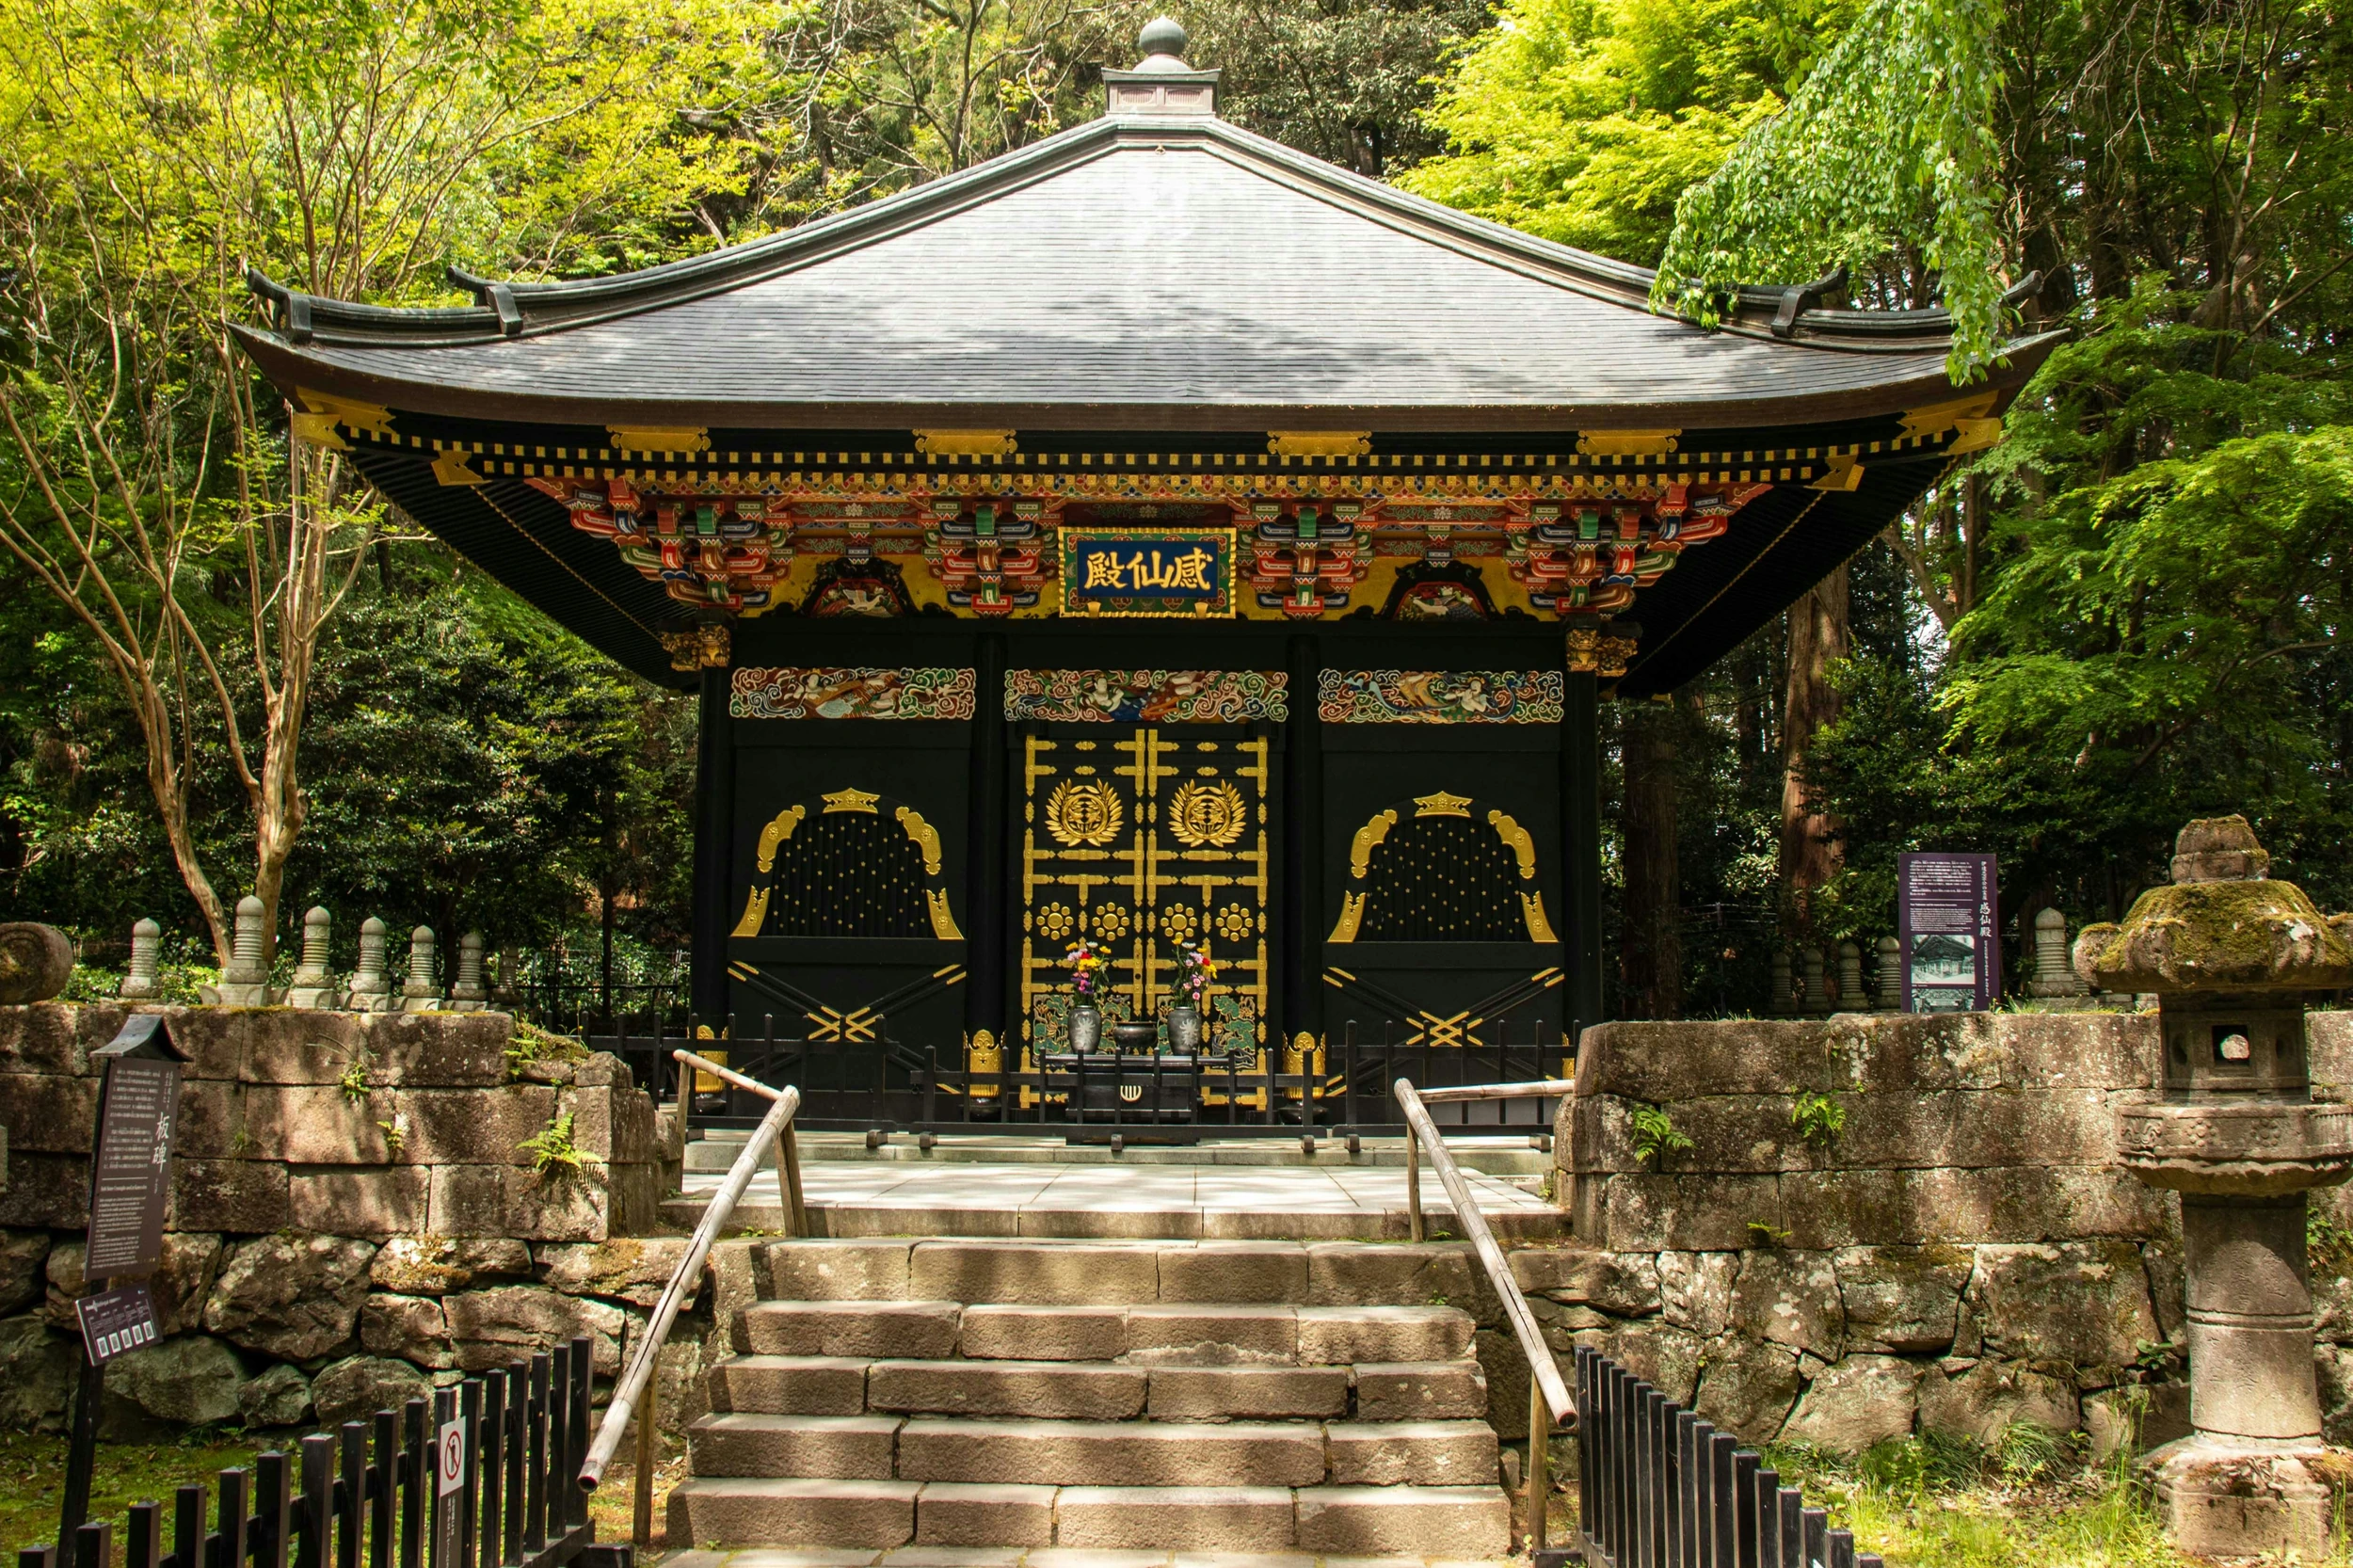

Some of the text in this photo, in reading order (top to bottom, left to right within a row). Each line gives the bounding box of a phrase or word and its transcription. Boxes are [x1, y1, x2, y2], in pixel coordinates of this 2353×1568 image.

[1979, 902, 1993, 937] 感仙殿
[152, 1112, 170, 1174] 板碑
